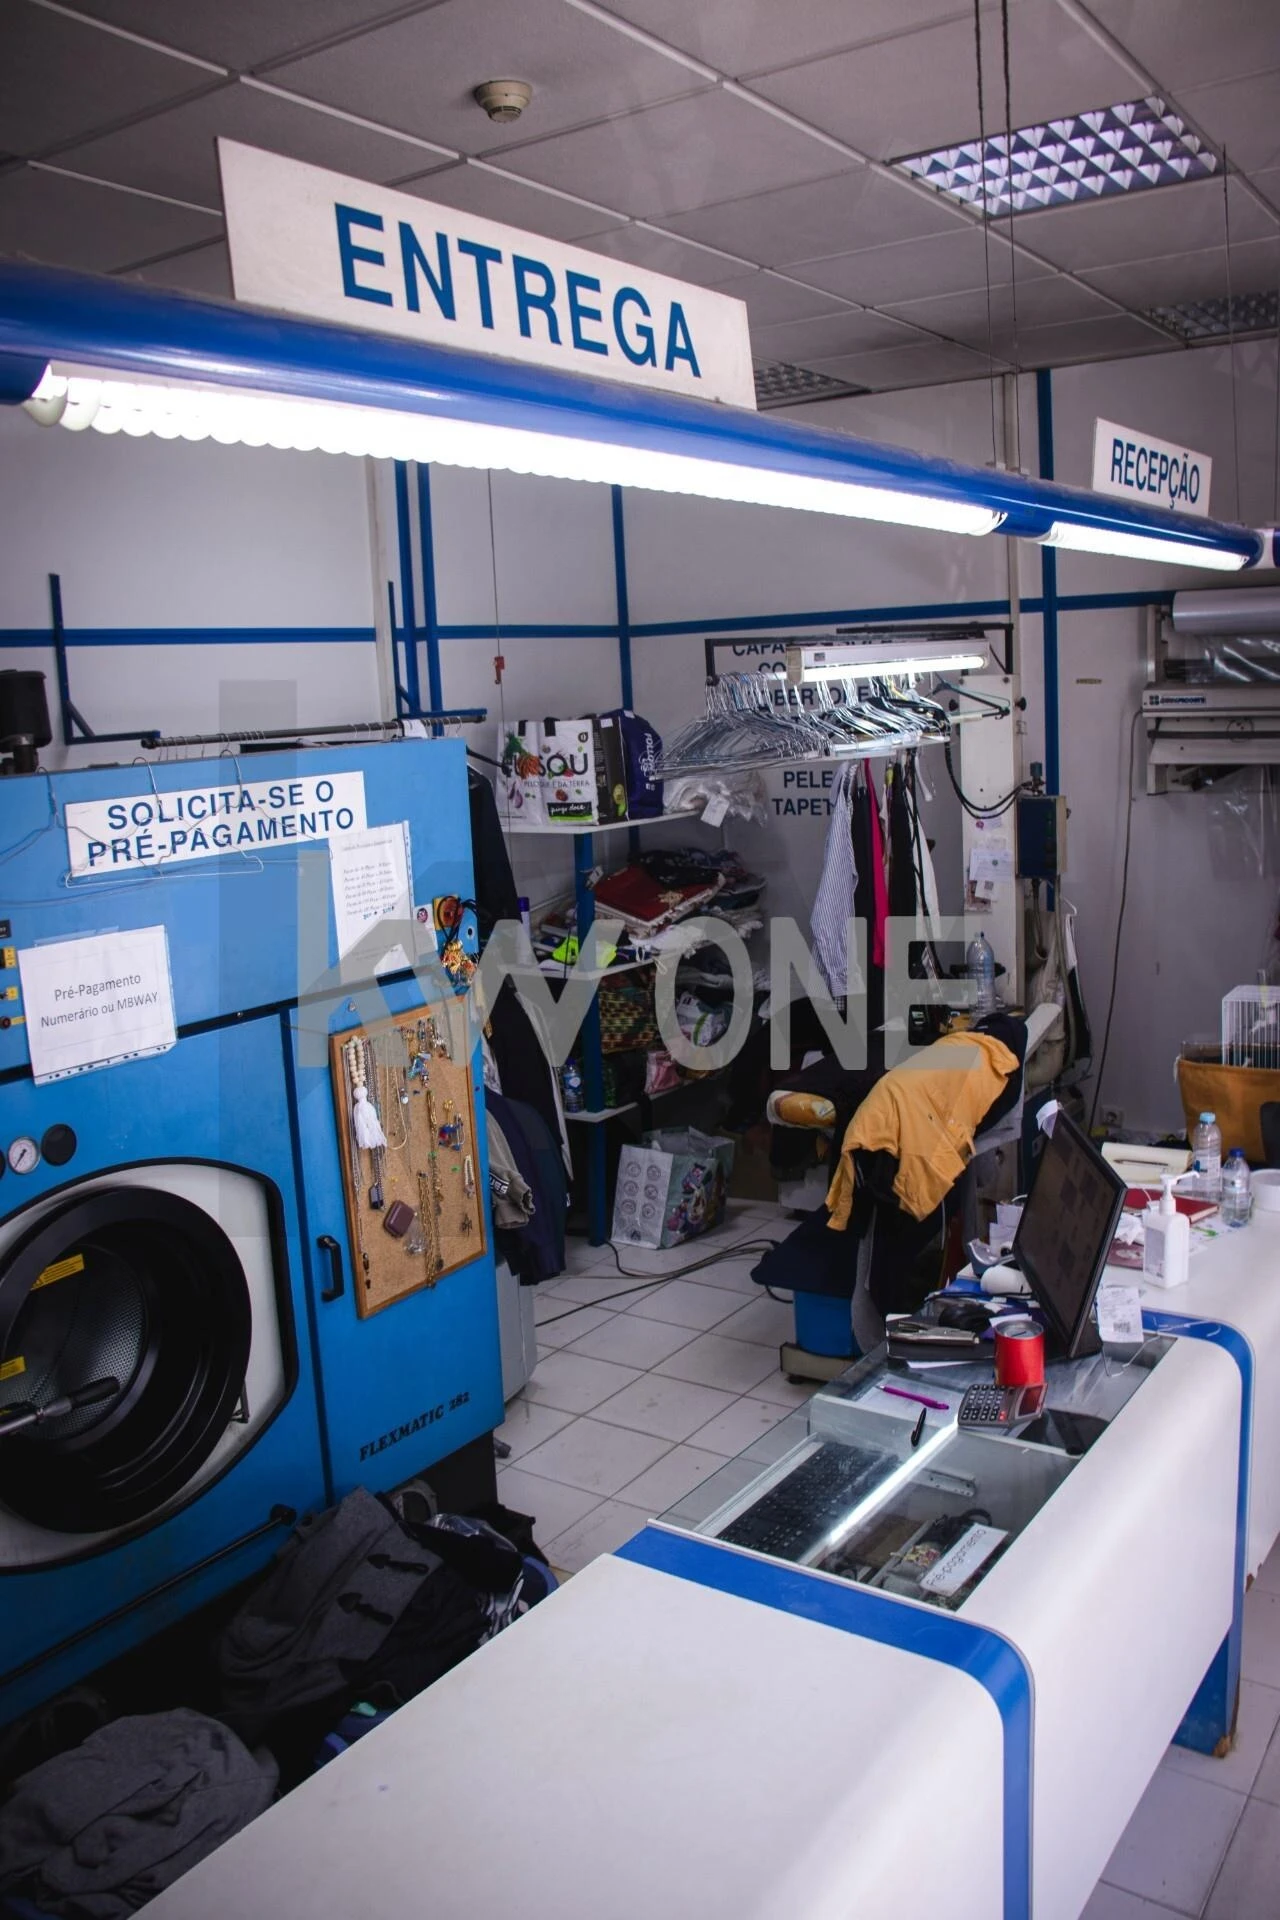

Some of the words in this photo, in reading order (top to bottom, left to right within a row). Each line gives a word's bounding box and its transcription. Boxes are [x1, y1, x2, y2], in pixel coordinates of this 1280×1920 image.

[334, 202, 701, 378] ENTREGA
[1111, 438, 1200, 509] RECEPÇÃO
[107, 783, 305, 830] SOLICITA-SE
[315, 780, 334, 803] O
[87, 807, 354, 867] PRÉ-PAGAMENTO
[40, 1005, 99, 1028] Numerário
[101, 1003, 115, 1015] ou
[117, 991, 158, 1011] MBWAY
[54, 974, 141, 1001] Pré-Pagamento
[359, 1404, 445, 1463] FLEXMATIC
